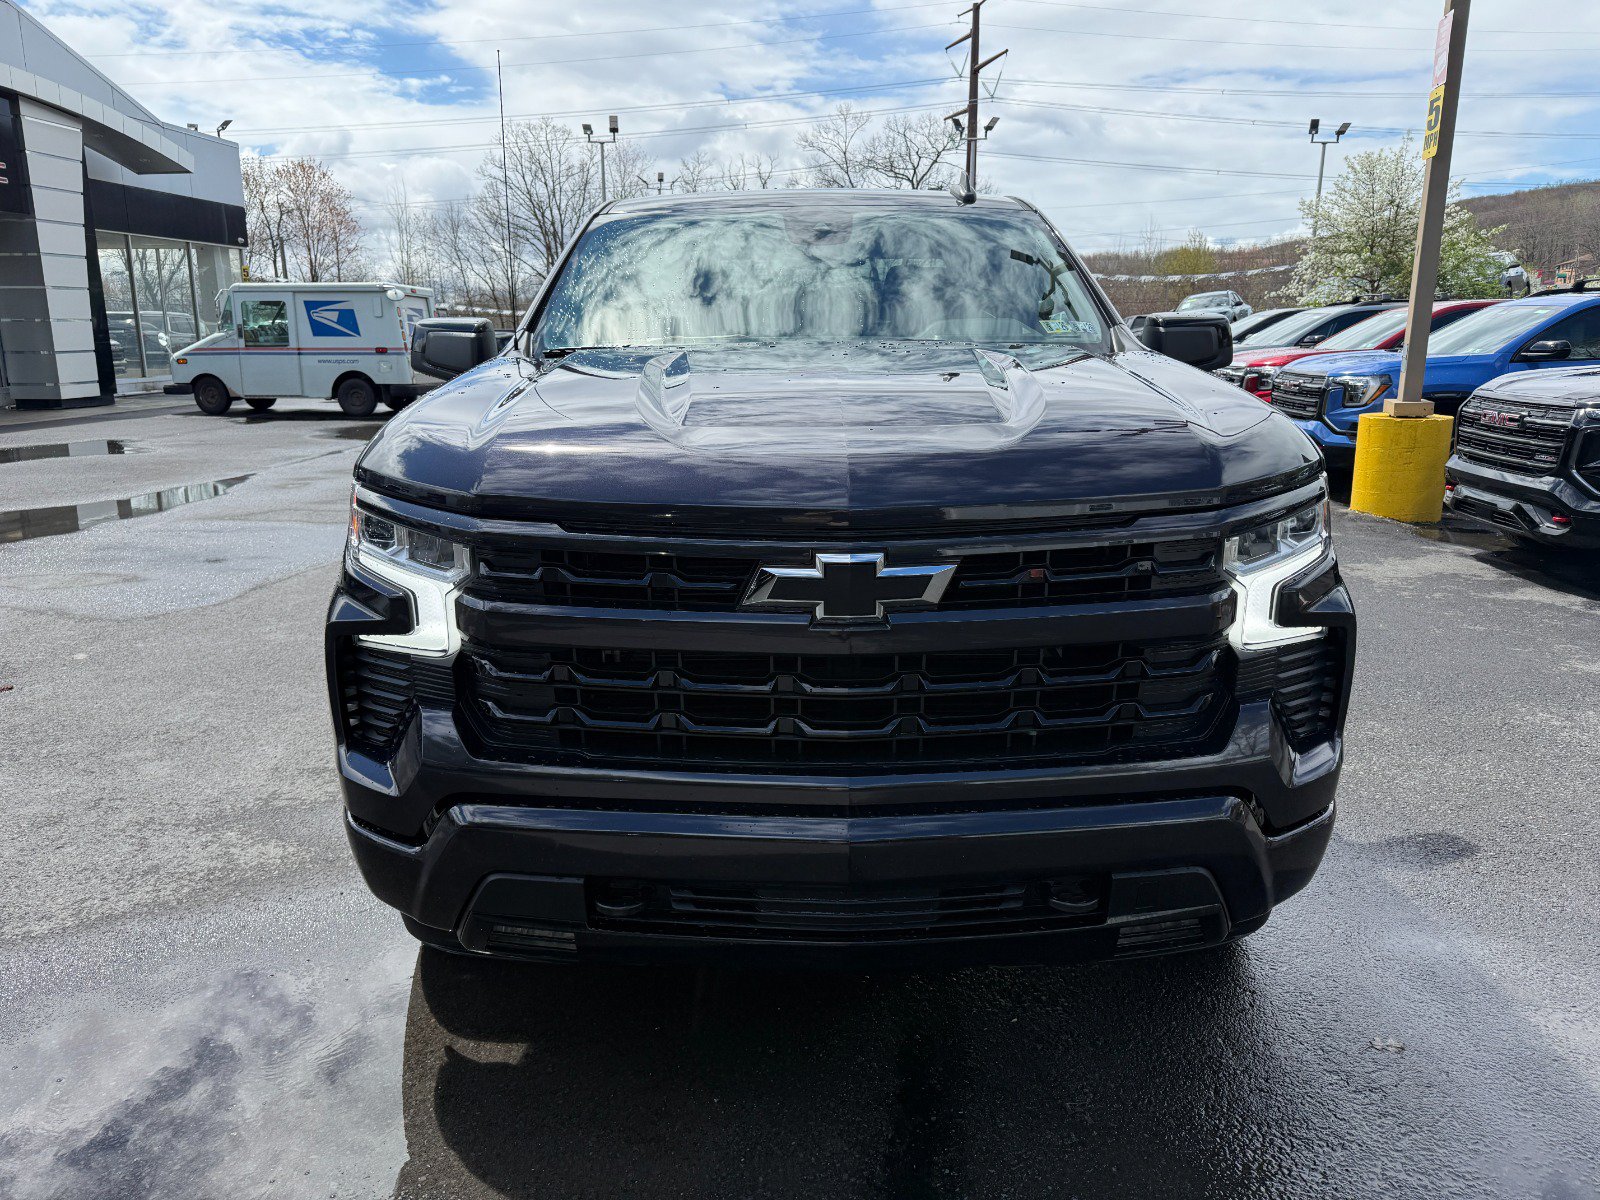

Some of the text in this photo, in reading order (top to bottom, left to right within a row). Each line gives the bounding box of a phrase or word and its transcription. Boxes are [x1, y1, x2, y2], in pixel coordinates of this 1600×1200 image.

[1427, 95, 1441, 131] 5
[1423, 131, 1438, 151] MPH
[243, 268, 249, 277] 5
[1481, 410, 1520, 427] GMC
